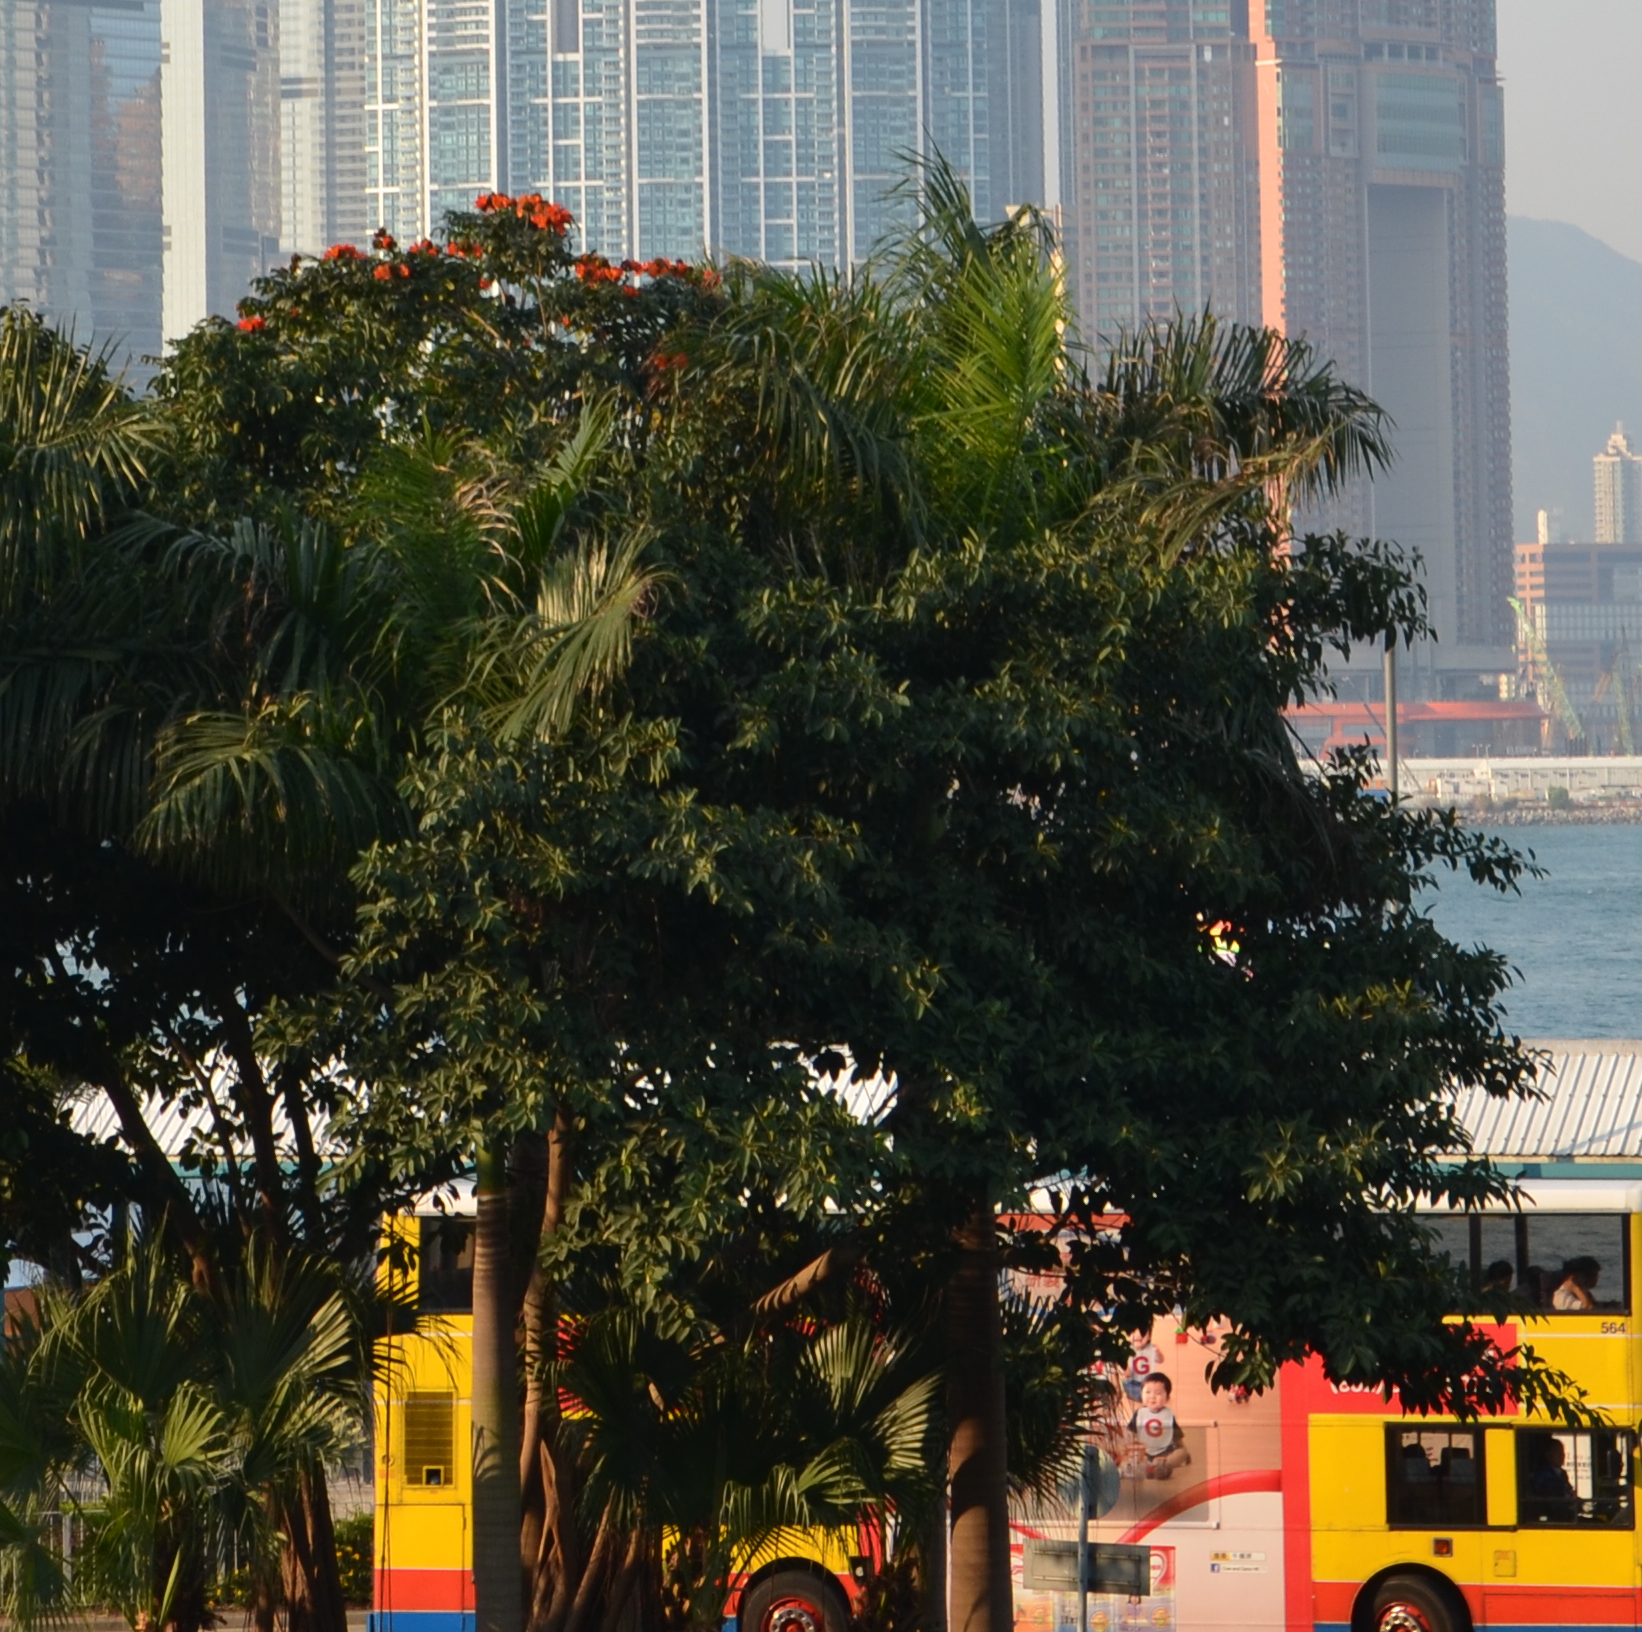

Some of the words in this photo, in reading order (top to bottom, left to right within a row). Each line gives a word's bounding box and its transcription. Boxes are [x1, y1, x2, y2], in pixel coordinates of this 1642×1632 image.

[1600, 1321, 1626, 1334] 564
[1133, 1356, 1150, 1375] G
[1145, 1419, 1163, 1438] G
